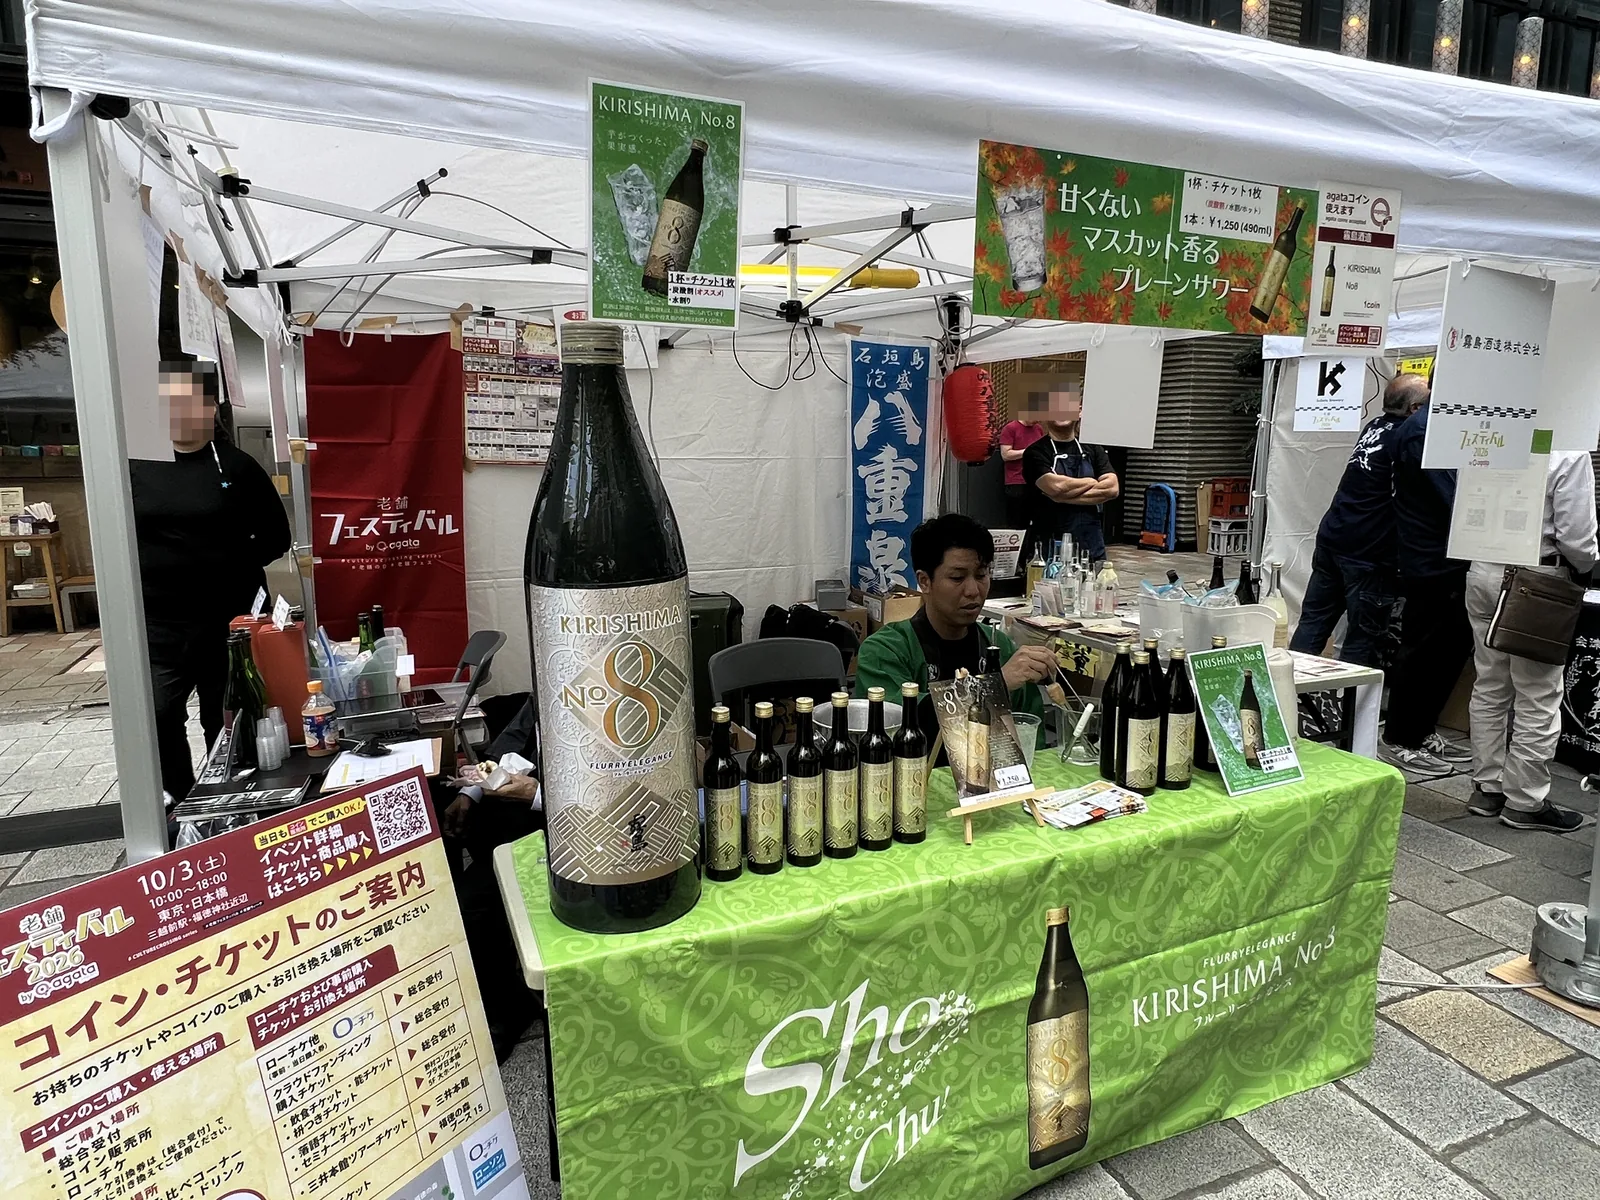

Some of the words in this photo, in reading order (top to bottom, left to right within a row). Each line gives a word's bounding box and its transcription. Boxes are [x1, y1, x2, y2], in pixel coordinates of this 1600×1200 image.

[599, 95, 692, 123] KIRISHIMA
[701, 111, 735, 129] No.8
[1057, 183, 1141, 219] 甘くない
[1325, 203, 1355, 216] 使えます
[1326, 192, 1370, 205] agataコイン
[1080, 224, 1220, 266] マスカット香る
[1113, 266, 1250, 302] プレーンサワー
[1345, 281, 1359, 290] No8
[1347, 264, 1382, 275] KIRISHIMA
[1363, 300, 1381, 309] 1coin
[855, 347, 925, 370] 石垣島
[1463, 334, 1541, 356] 霧島酒造株式会社
[866, 369, 913, 391] 泡盛
[1460, 430, 1505, 450] フェスティバル
[377, 496, 408, 511] 老舗
[320, 509, 459, 546] フェスティバル
[366, 543, 374, 551] by
[560, 605, 681, 634] KIRISHIMA
[1194, 654, 1241, 670] KIRISHIMA
[1244, 650, 1263, 661] No.8
[590, 751, 673, 770] FLURRYELEGANCE
[259, 829, 288, 846] 当日も
[260, 823, 344, 866] イベント詳細
[263, 830, 371, 884] チケット・商品購入
[267, 866, 322, 899] はこちら
[20, 906, 65, 933] 老舗
[147, 893, 249, 941] 三越前駅・福徳神社近辺
[157, 886, 229, 923] 東京・日本橋
[14, 861, 426, 1070] コイン・チケットのご案内
[25, 946, 84, 984] 2026
[1203, 931, 1297, 968] FLURRYELEGANCE
[21, 992, 33, 1003] by
[254, 958, 374, 1027] ローチケおよび事前購入
[407, 969, 443, 997] 総合受付
[1132, 955, 1283, 1027] KIRISHIMA
[32, 903, 430, 1106] お持ちのチケットやコインのご購入・お引き換え場所をご確認ください
[414, 996, 450, 1024] 総合受付
[265, 1033, 320, 1071] ローチケ他
[421, 1023, 457, 1051] 総合受付
[273, 1034, 372, 1101] クラウドファンディング
[30, 1037, 218, 1143] コインのご購入・使える場所
[275, 1073, 334, 1113] 購入チケット
[290, 1089, 341, 1126] 飲食チケット
[354, 1057, 393, 1088] 能チケット
[435, 1076, 470, 1107] 三井本館
[65, 1102, 141, 1150] ご購入場所
[438, 1101, 471, 1130] 福徳の森
[450, 1113, 472, 1132] ブース
[474, 1103, 483, 1115] 15
[58, 1128, 122, 1171] 総合受付
[298, 1116, 354, 1158] 落語チケット
[302, 1116, 374, 1168] セミナーチケット
[850, 1085, 950, 1193] Chu!
[63, 1127, 153, 1185] コイン販売所
[308, 1118, 409, 1194] 三井本館ツアーチケット
[474, 1154, 504, 1181] ローソン
[68, 1158, 127, 1198] ローチケ
